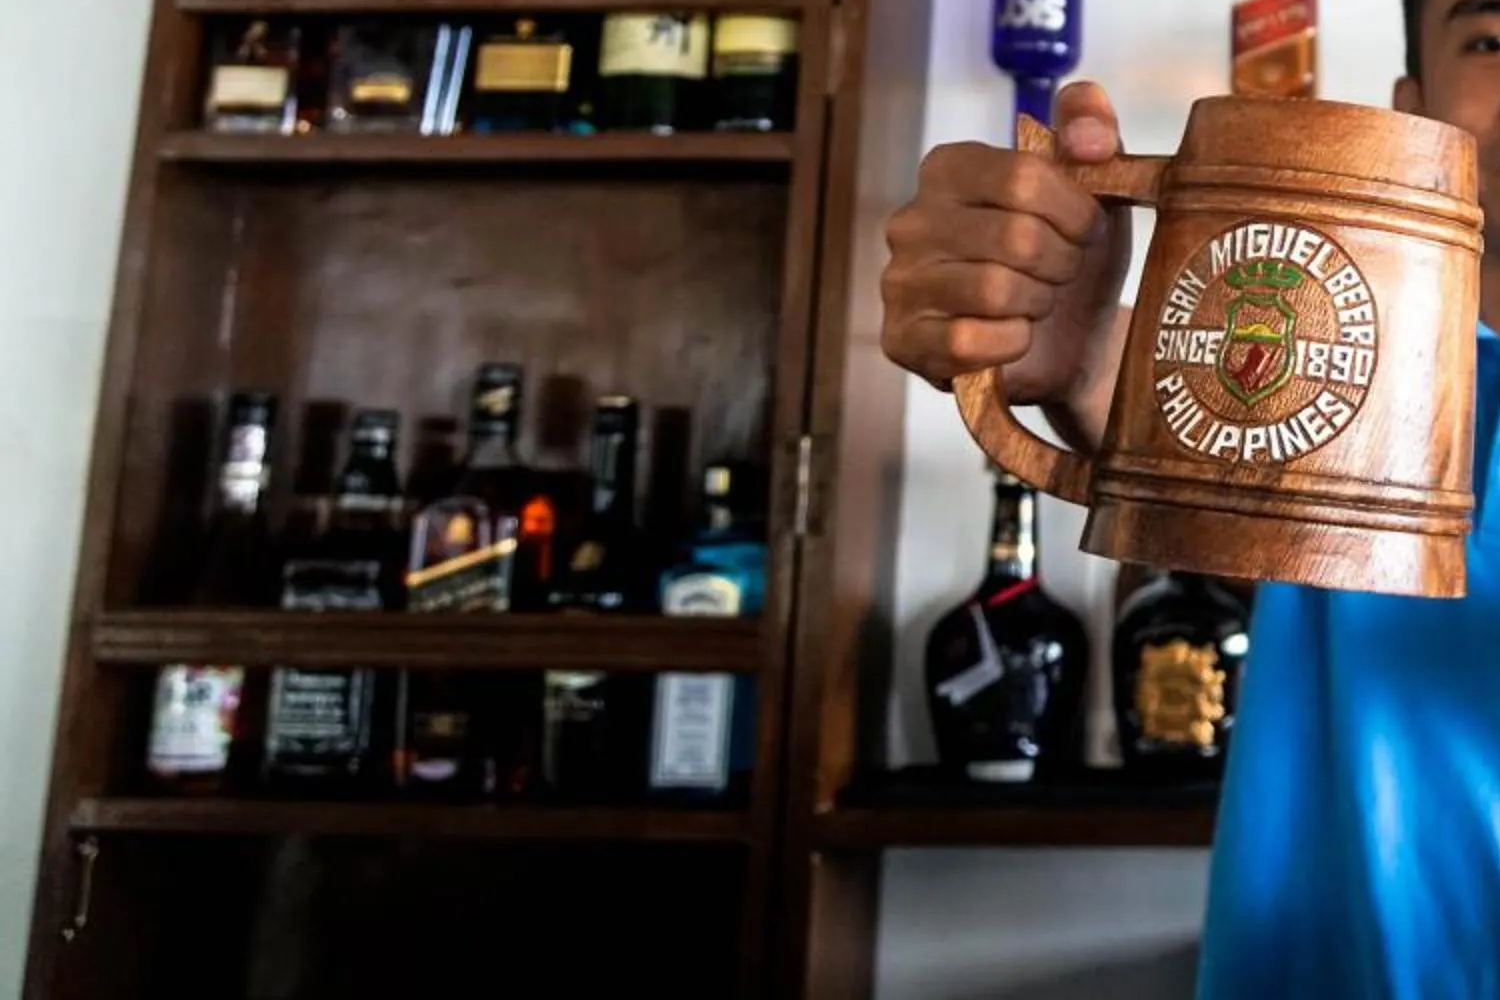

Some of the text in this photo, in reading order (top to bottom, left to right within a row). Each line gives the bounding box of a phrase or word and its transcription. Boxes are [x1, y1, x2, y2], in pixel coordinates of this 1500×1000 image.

[1162, 223, 1378, 345] SAN MIGUEL BEER
[1155, 329, 1373, 385] SINCE 1890
[1156, 372, 1351, 461] PHILIPPINES
